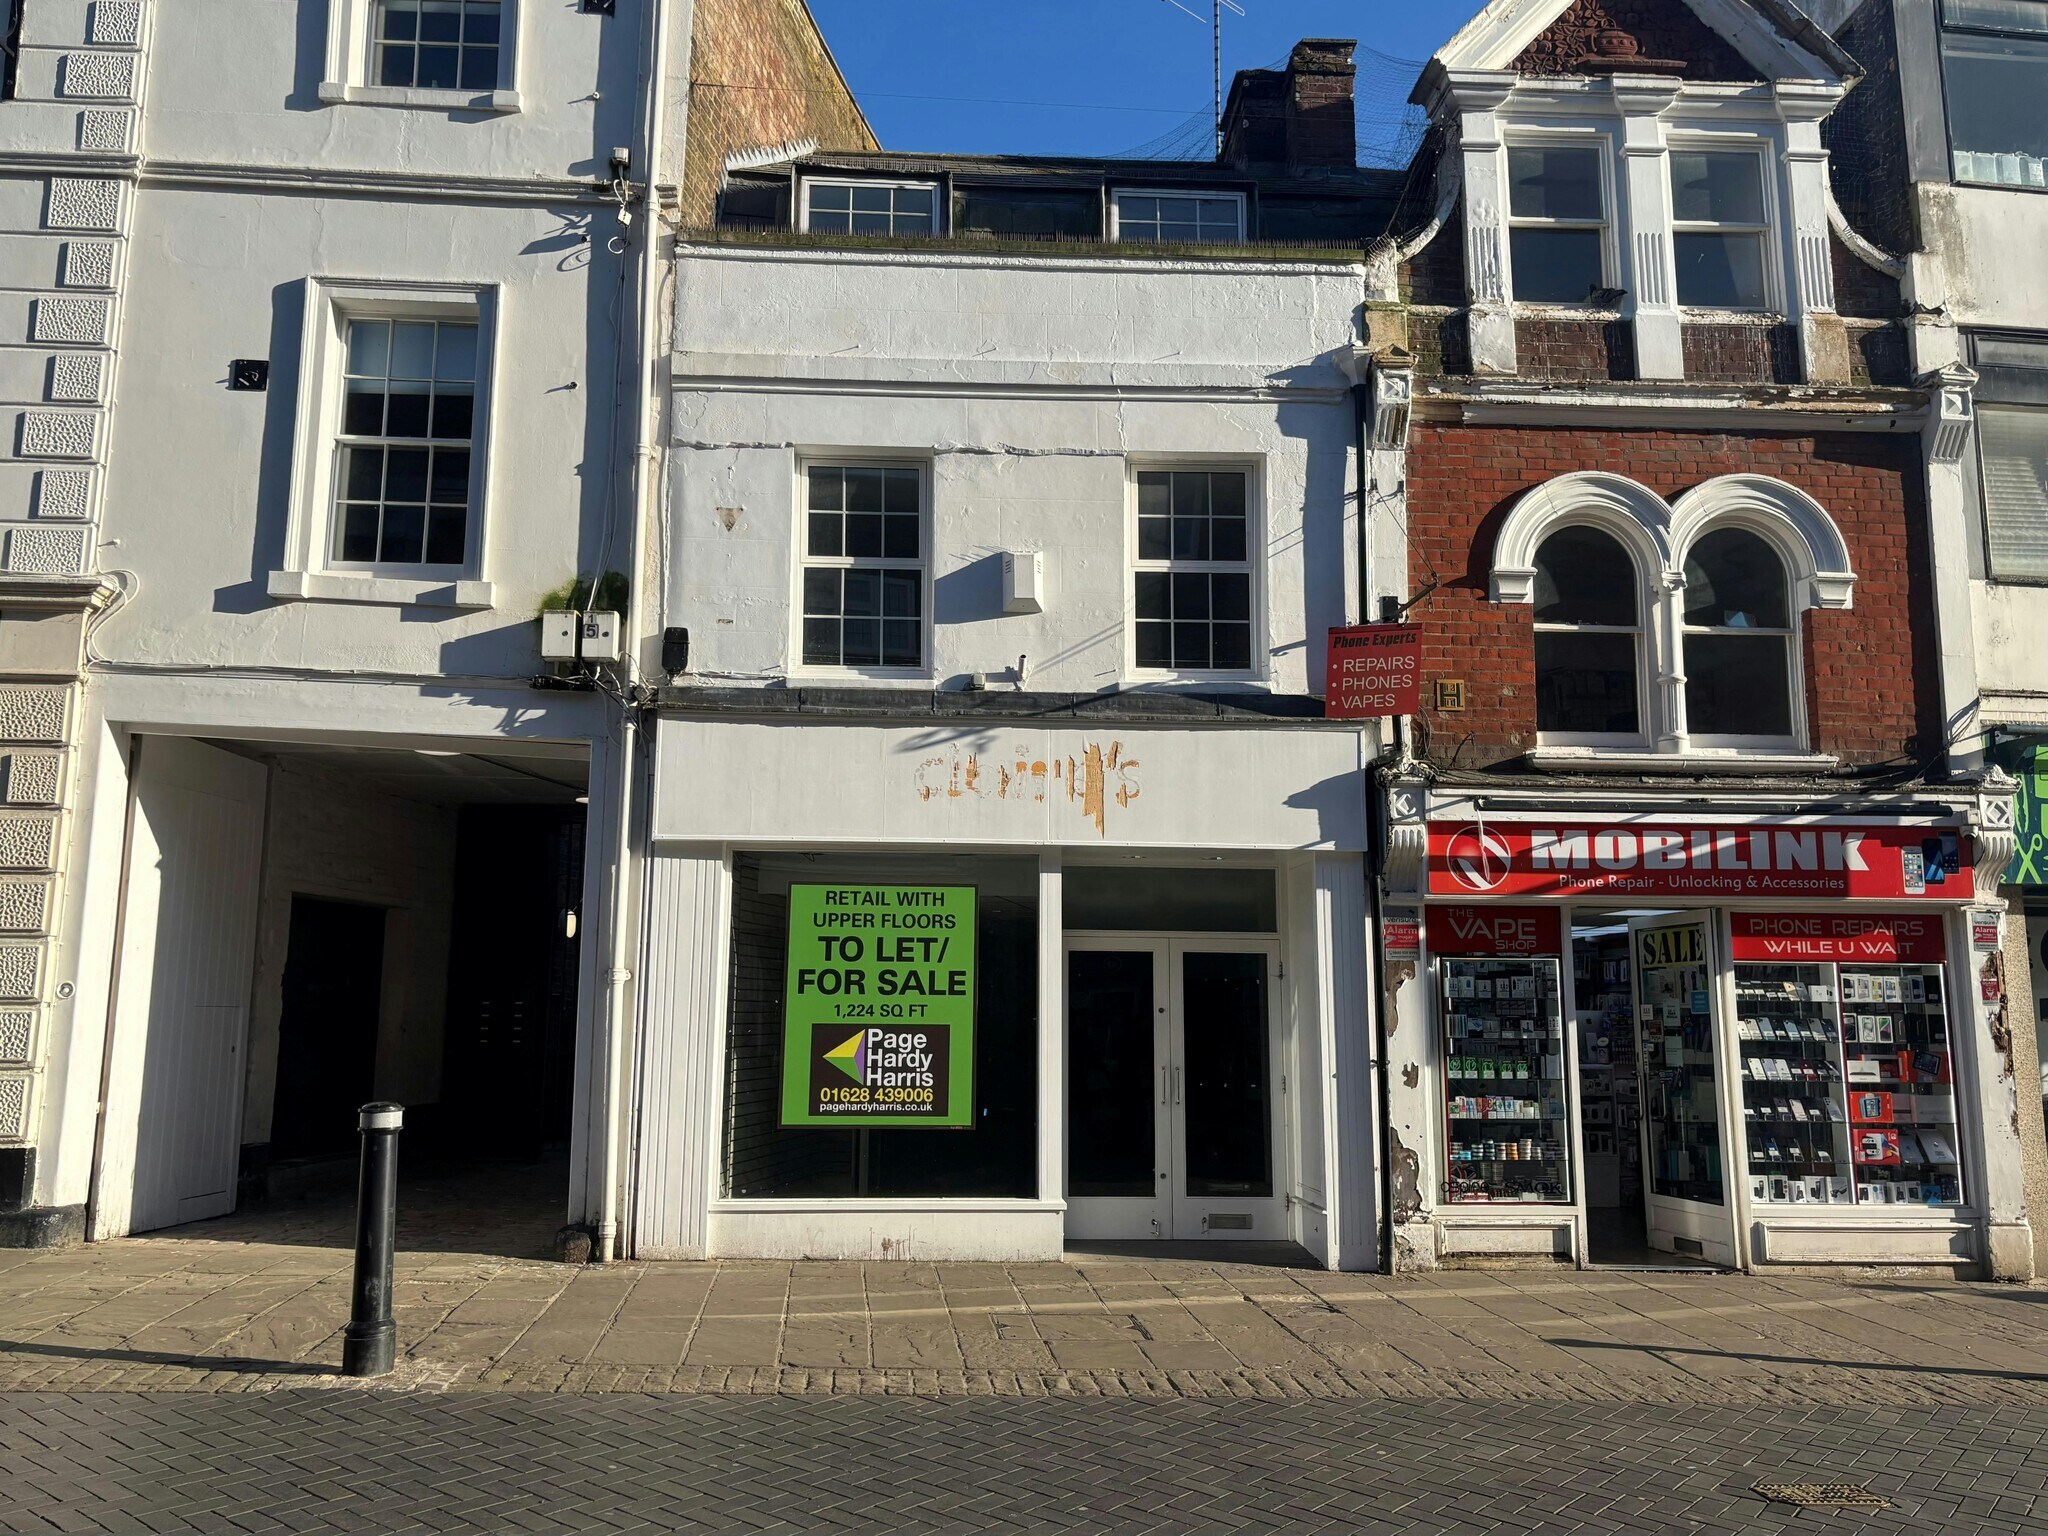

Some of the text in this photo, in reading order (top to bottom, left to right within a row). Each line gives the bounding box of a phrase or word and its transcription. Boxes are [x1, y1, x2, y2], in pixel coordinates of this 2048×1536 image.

[586, 625, 596, 637] 5
[1333, 632, 1417, 648] Phone Experts
[1343, 656, 1415, 672] REPAIRS
[1342, 675, 1412, 690] PHONES
[1341, 694, 1396, 709] VAPES
[1531, 829, 1869, 871] MOBILINK
[1559, 875, 1604, 888] Phone
[1609, 875, 1654, 891] Repair
[1669, 875, 1742, 891] Unlocking
[1746, 876, 1758, 888] &
[1762, 875, 1844, 889] Accessories
[825, 890, 945, 907] RETAIL WITH
[813, 912, 956, 929] UPPER FLOORS
[1448, 908, 1474, 917] THE
[1387, 925, 1418, 934] Alarm
[1448, 918, 1536, 939] VAPE
[1750, 919, 1924, 936] PHONE REPAIRS
[818, 936, 950, 964] TO LET/
[1496, 940, 1537, 950] SHOP
[1643, 928, 1704, 966] SALE
[1763, 940, 1914, 955] WHILE U WAIT
[797, 968, 967, 996] FOR SALE
[834, 1004, 928, 1019] 1,224 SQ FT
[867, 1028, 927, 1052] Page
[866, 1048, 933, 1071] Hardy
[866, 1067, 934, 1087] Harris
[820, 1087, 934, 1102] 01628 439006
[819, 1102, 933, 1112] pagehardyharris.co.uk
